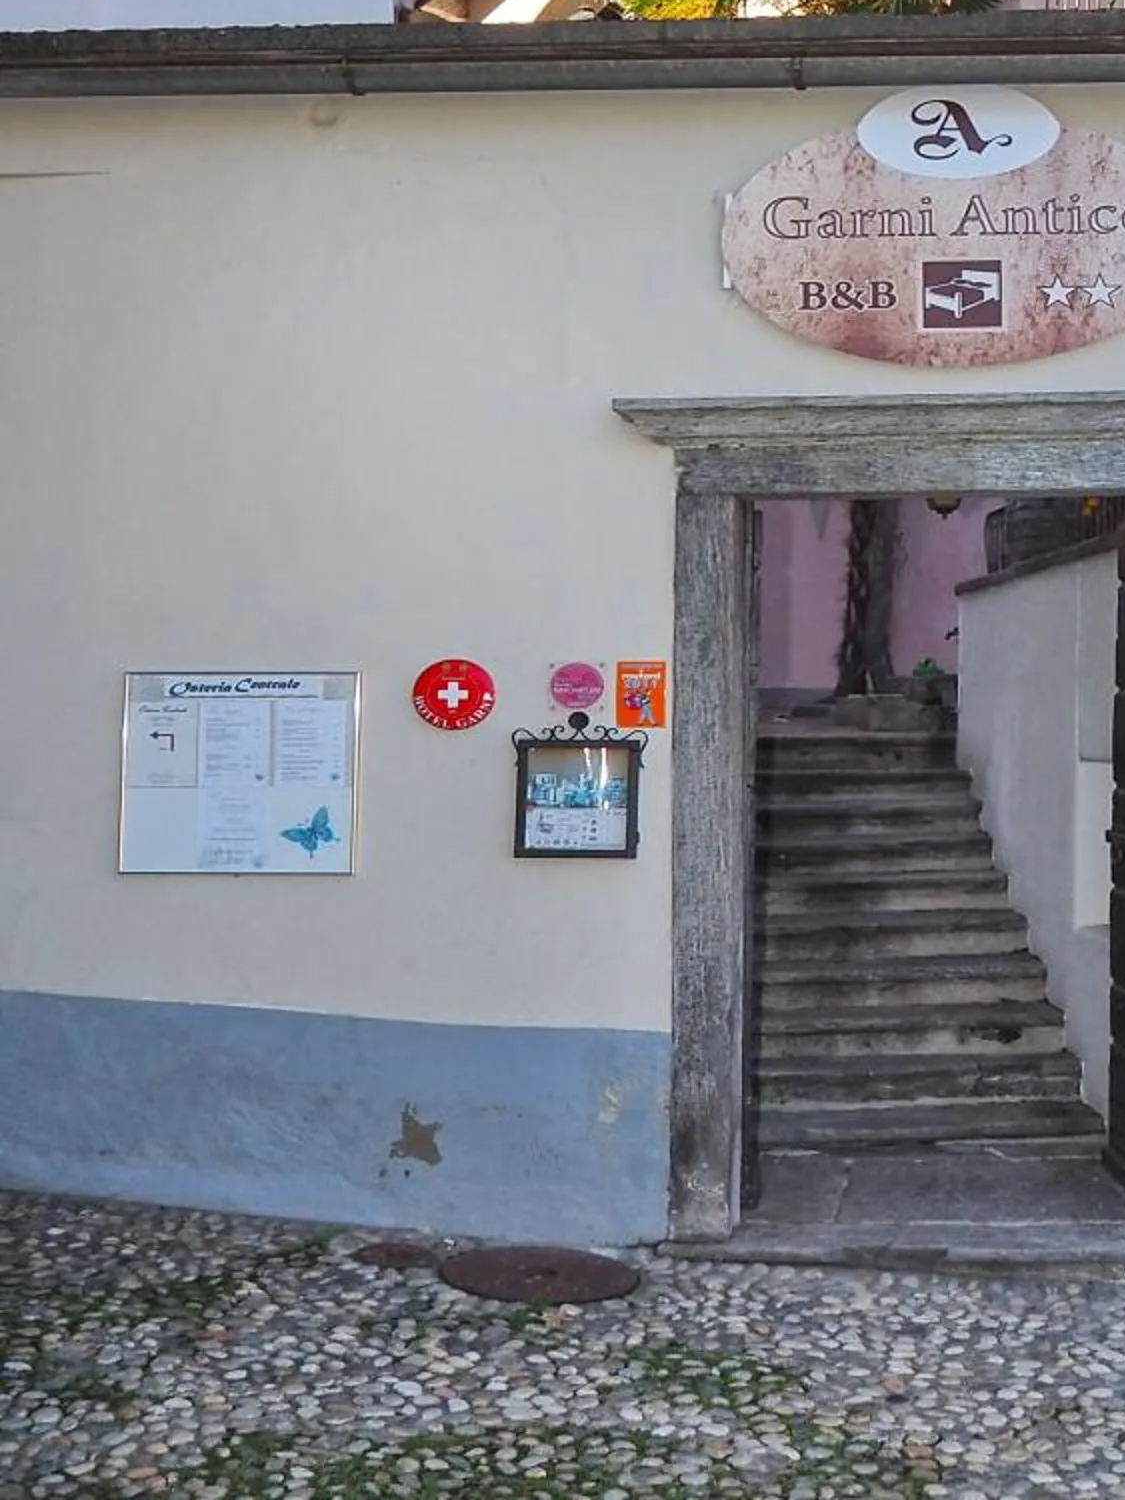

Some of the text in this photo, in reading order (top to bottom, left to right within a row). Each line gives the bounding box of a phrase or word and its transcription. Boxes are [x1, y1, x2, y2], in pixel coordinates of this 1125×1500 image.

[910, 99, 1013, 161] A
[762, 195, 938, 240] Garni
[799, 280, 898, 311] B&B
[415, 695, 449, 728] HOTEL
